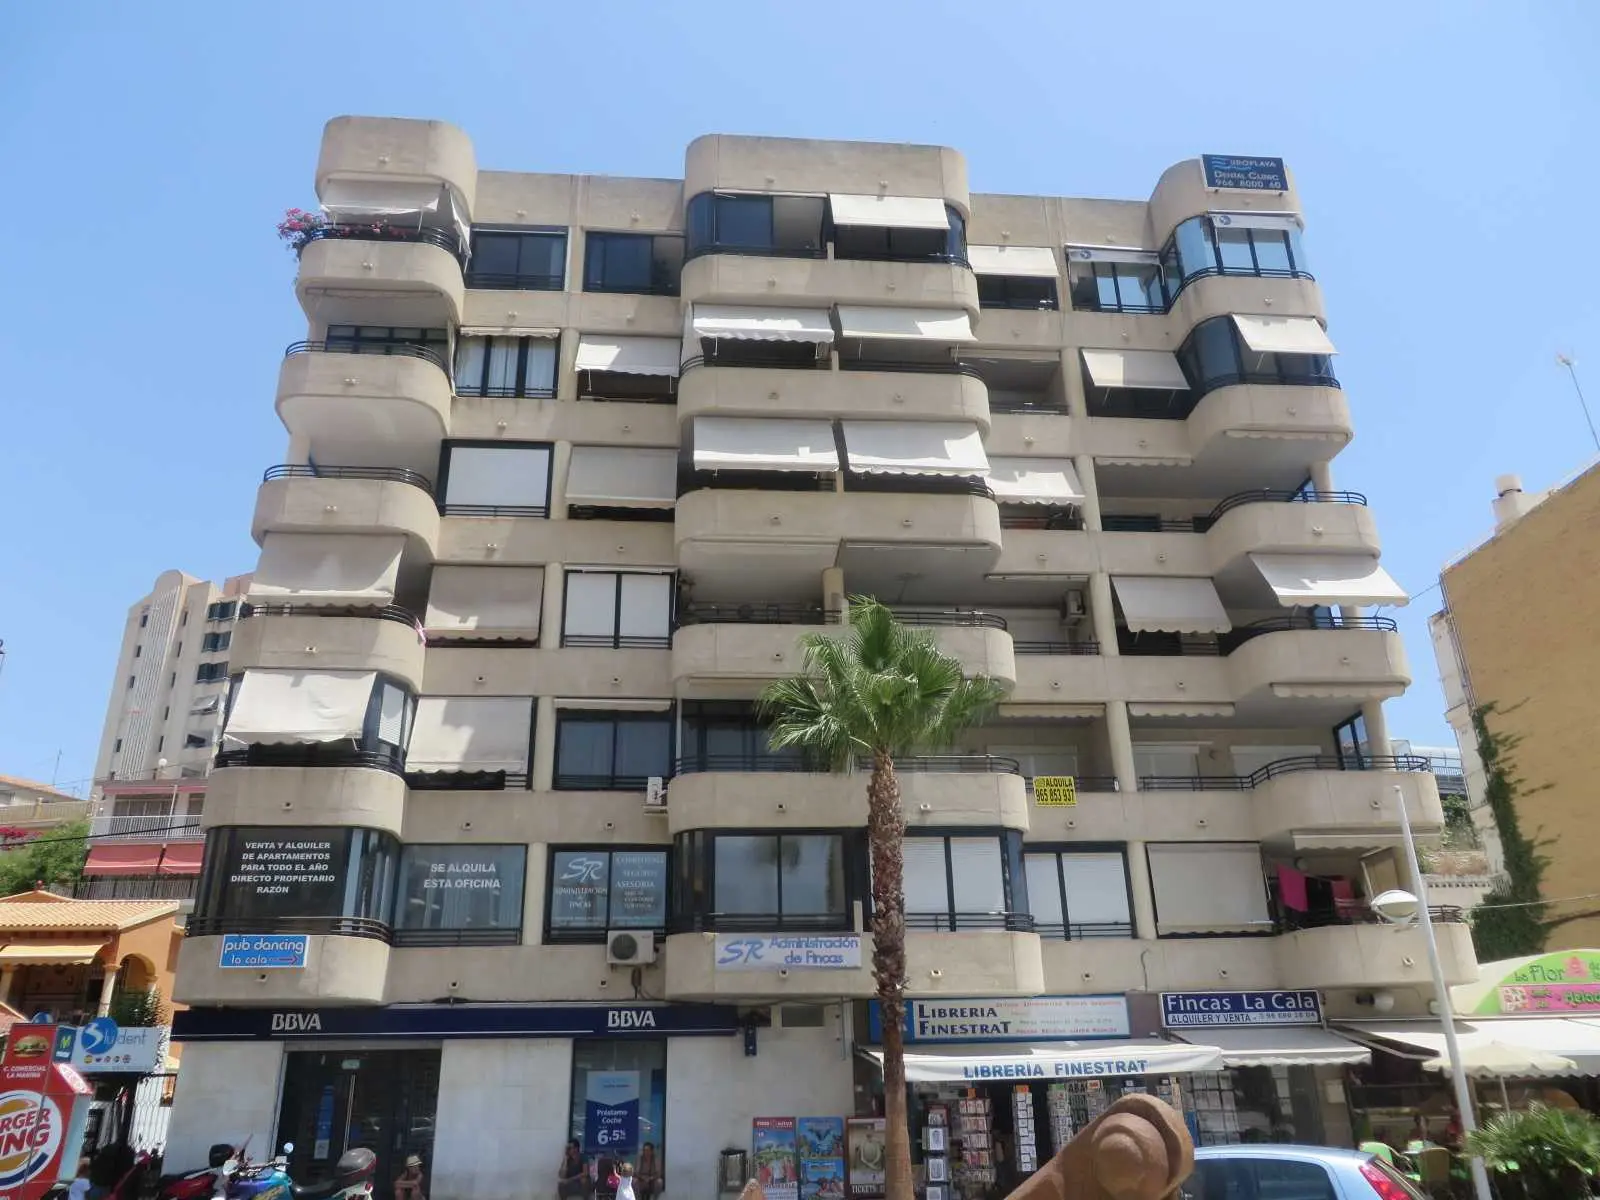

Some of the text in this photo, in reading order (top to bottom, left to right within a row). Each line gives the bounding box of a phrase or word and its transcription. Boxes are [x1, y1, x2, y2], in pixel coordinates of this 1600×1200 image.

[1046, 777, 1073, 787] ALQUILA
[1035, 788, 1048, 802] 965
[308, 862, 329, 871] AÑO
[431, 863, 497, 873] SE ALQUILA
[256, 885, 289, 893] RAZÓN
[423, 879, 502, 888] ESTA OFICINA
[224, 938, 304, 954] pub dancing
[769, 936, 858, 949] Administración
[717, 938, 765, 964] SR
[784, 951, 844, 964] de Fincas
[1529, 965, 1565, 982] Flor
[1166, 992, 1315, 1011] Fincas La Cala
[918, 1004, 998, 1019] LIBRERIA
[1171, 1014, 1214, 1024] ALQUILER
[1215, 1014, 1222, 1023] Y
[1223, 1013, 1251, 1023] VENTA
[271, 1013, 322, 1031] BBVA
[607, 1010, 656, 1028] BBVA
[919, 1020, 1012, 1035] FINESTRAT
[1054, 1059, 1148, 1076] FINESTRAT
